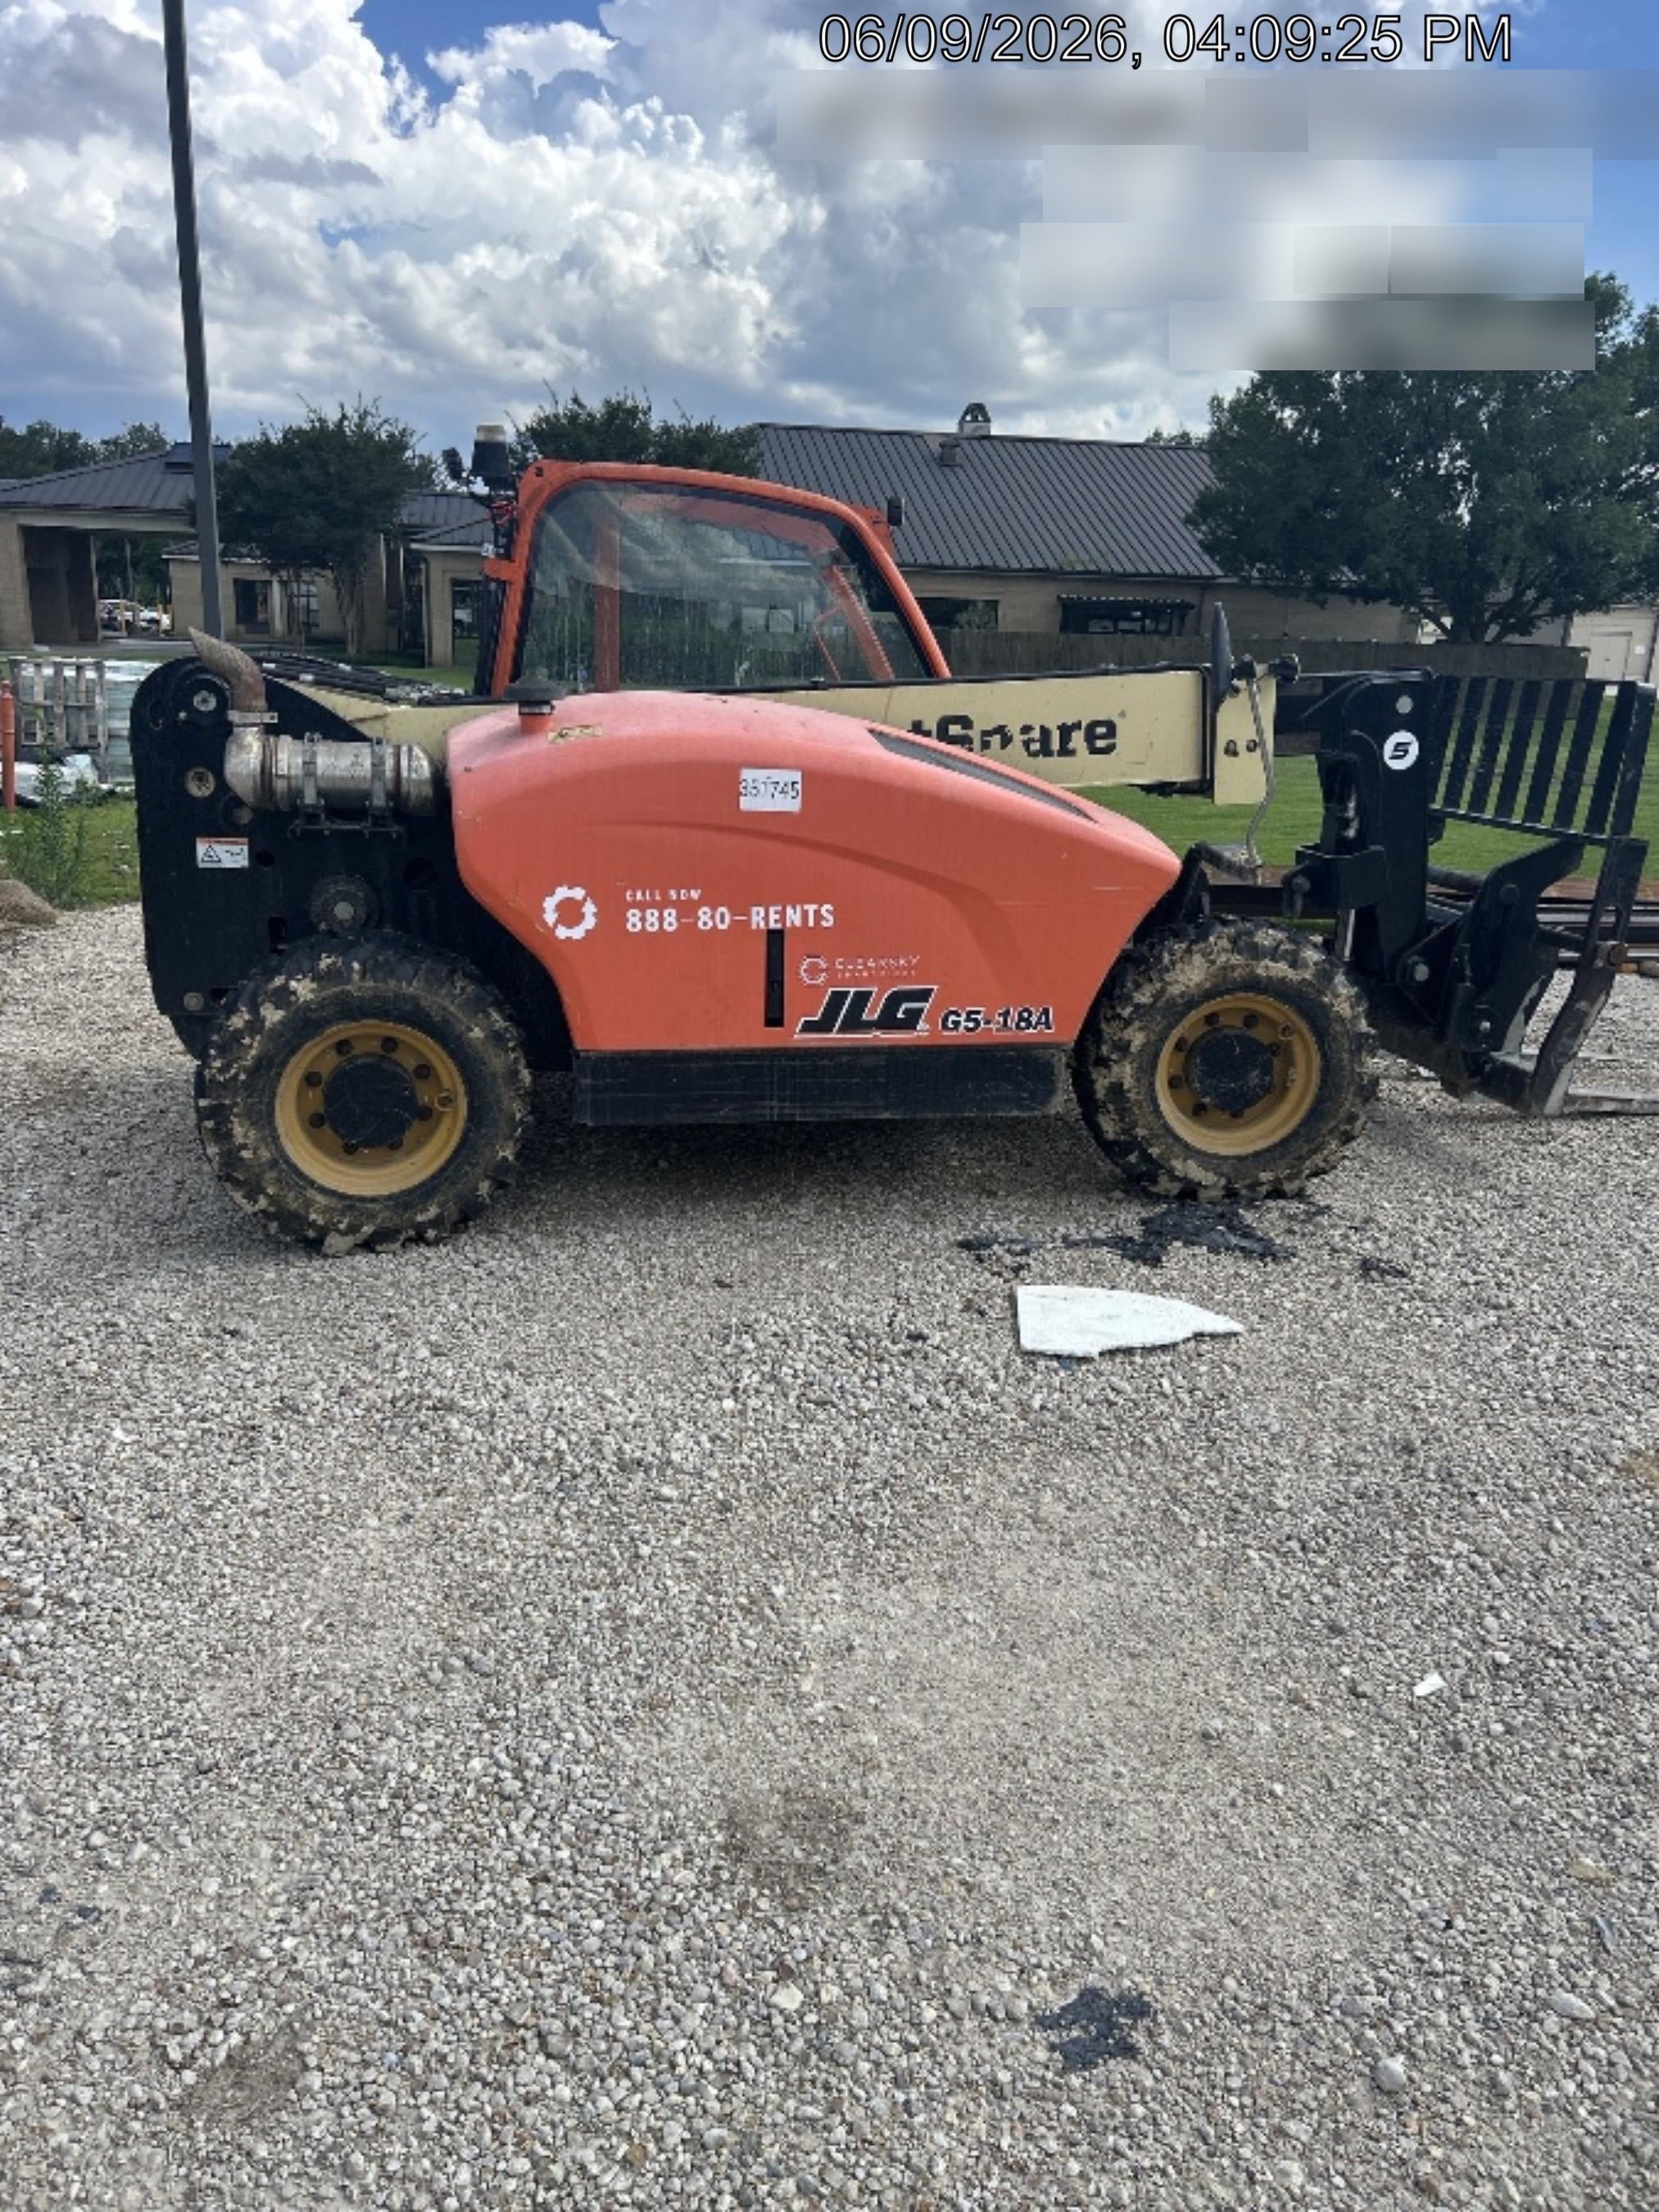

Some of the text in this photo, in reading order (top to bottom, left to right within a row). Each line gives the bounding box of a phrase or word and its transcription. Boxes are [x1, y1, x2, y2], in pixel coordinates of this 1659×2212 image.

[625, 889, 662, 902] CALL
[625, 904, 835, 933] 888-80-RENTS
[793, 985, 1055, 1037] JLG G5-18A
